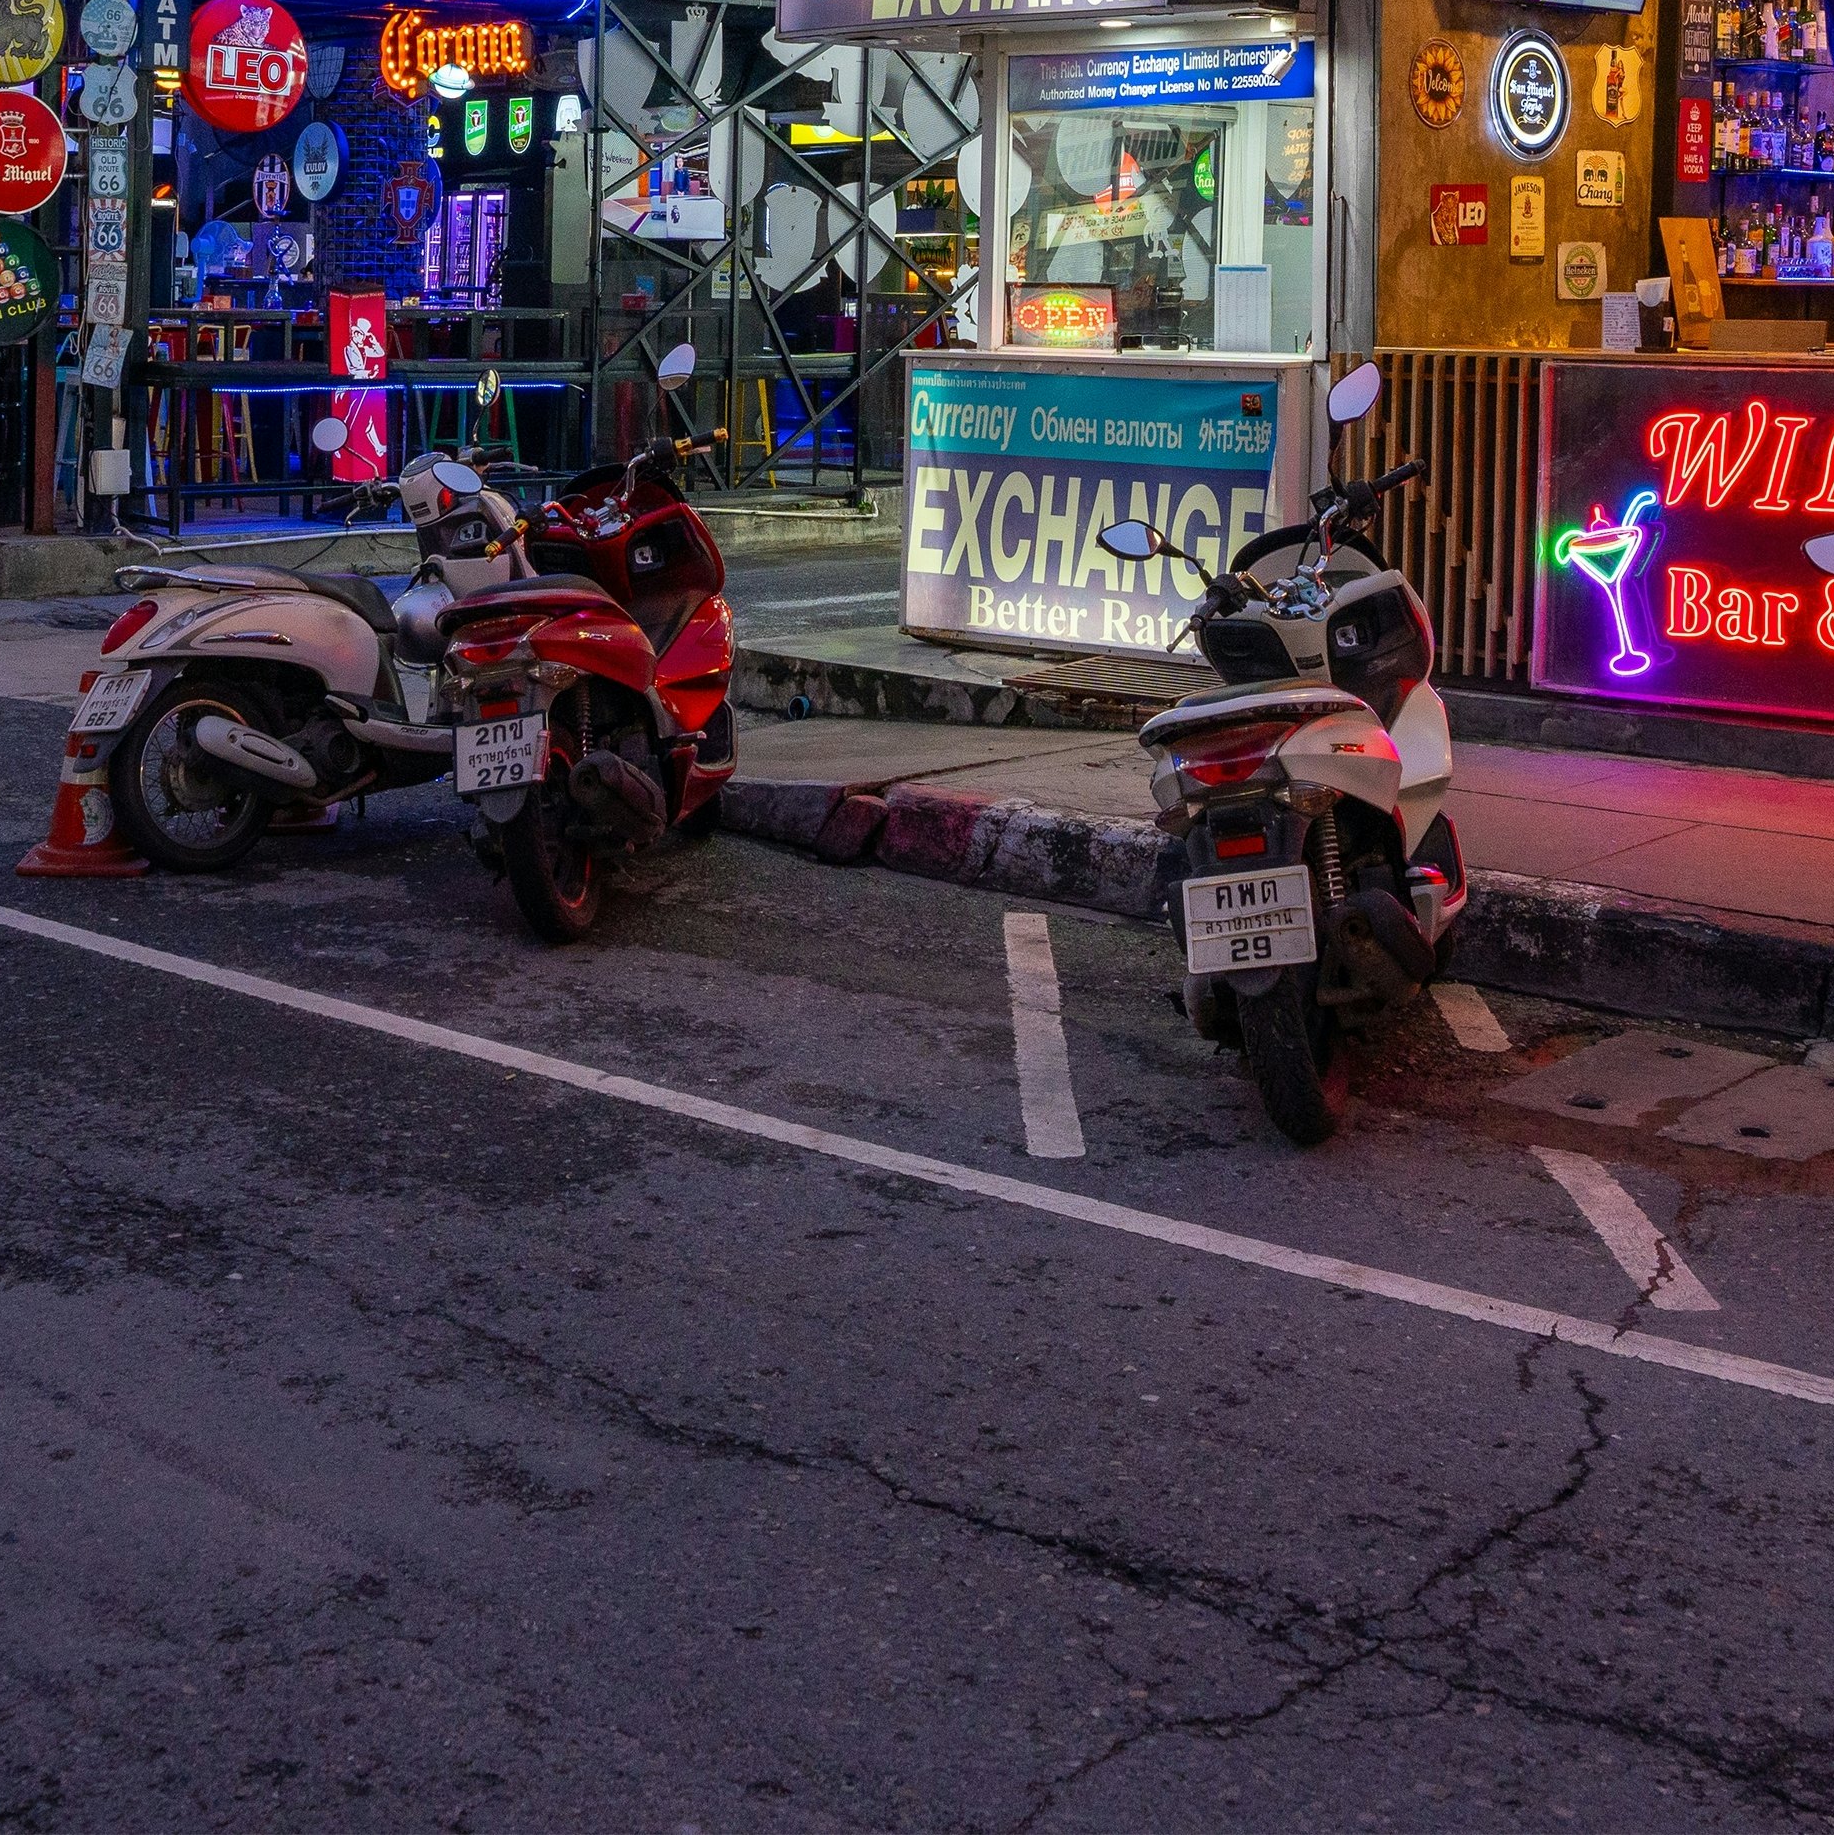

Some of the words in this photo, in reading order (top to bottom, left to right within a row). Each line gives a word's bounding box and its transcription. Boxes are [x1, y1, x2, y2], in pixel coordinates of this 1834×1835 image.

[1682, 3, 1713, 26] Alcohol
[380, 10, 527, 100] Corona
[210, 48, 292, 94] LEO
[1040, 62, 1058, 81] The
[1087, 58, 1129, 79] Currency
[1132, 53, 1181, 76] Exchange
[1183, 50, 1220, 71] Limited
[97, 84, 119, 95] US
[1039, 85, 1086, 101] Authorized
[1088, 82, 1117, 99] Money
[1119, 80, 1158, 98] Changer
[1159, 79, 1195, 94] License
[1197, 77, 1211, 92] No
[1213, 76, 1229, 91] Mc
[1509, 79, 1526, 94] San
[1526, 80, 1555, 98] Miguel
[92, 96, 125, 117] 66
[1685, 133, 1704, 143] CALM
[1687, 124, 1702, 133] KEEP
[91, 137, 127, 149] HISTORIC
[97, 165, 120, 173] ROUTE
[100, 155, 117, 165] OLD
[304, 160, 328, 175] KULOV
[1683, 154, 1699, 164] HAVE
[4, 164, 54, 186] Miguel
[256, 172, 288, 183] JUVENTUS
[1683, 164, 1704, 175] VODKA
[98, 174, 120, 192] 66
[1513, 182, 1542, 196] JAMESON
[1578, 183, 1613, 203] Chang
[97, 211, 119, 221] ROUTE
[1458, 201, 1485, 228] LEO
[97, 224, 119, 247] 66
[1565, 266, 1596, 275] Heineken
[98, 285, 119, 295] ROUTE
[5, 298, 48, 320] CLUB
[97, 295, 116, 315] 66
[1018, 301, 1108, 332] OPEN
[92, 359, 114, 378] 66
[911, 389, 1017, 453] Currency
[1031, 404, 1098, 441] Обмен
[1104, 417, 1184, 450] валюты
[1198, 416, 1272, 456] 外币兑换
[906, 466, 1266, 602] EXCHANGE
[967, 584, 1088, 642] Better
[1665, 565, 1801, 646] Bar
[84, 711, 117, 727] 667
[468, 743, 532, 768] สุราษฎร์ธานี
[477, 763, 524, 787] 279
[1230, 935, 1273, 962] 29
